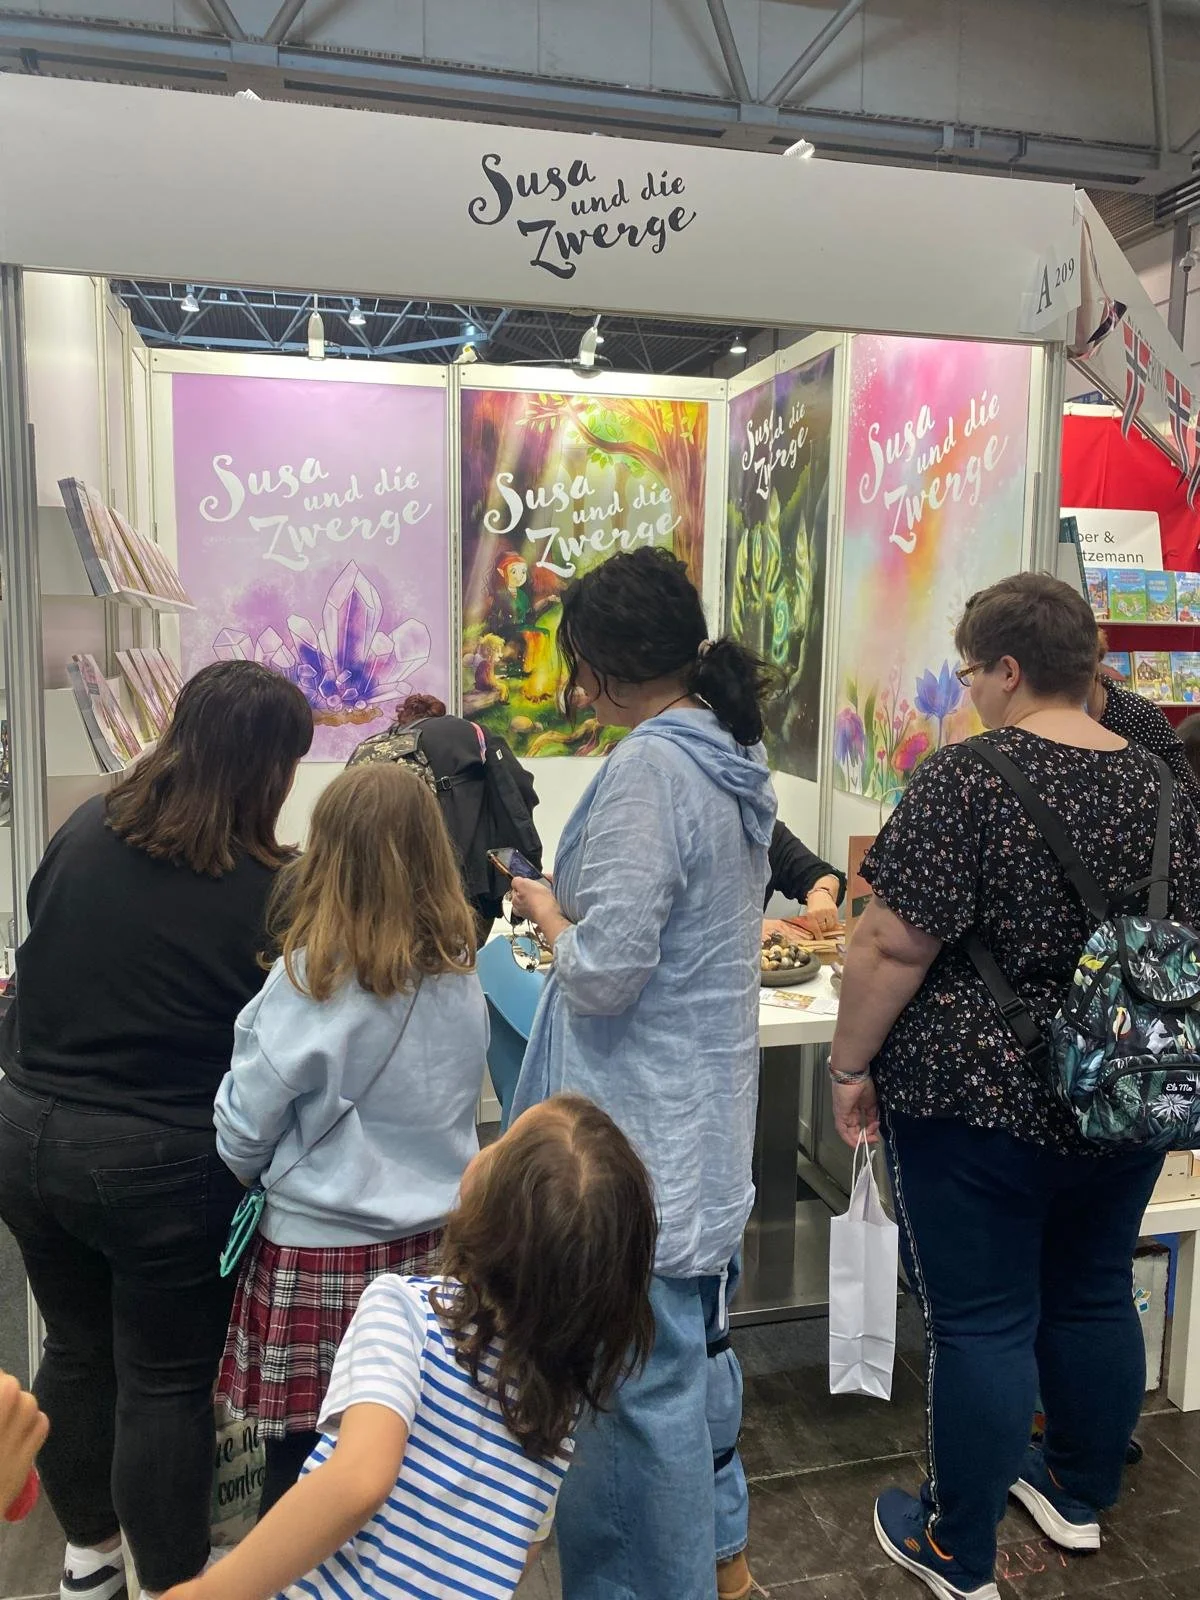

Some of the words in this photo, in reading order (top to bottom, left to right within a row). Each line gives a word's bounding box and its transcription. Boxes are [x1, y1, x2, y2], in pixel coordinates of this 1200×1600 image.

[468, 153, 596, 225] Susa
[571, 178, 630, 216] und
[641, 170, 685, 201] die
[516, 206, 697, 280] Zwerge
[1036, 264, 1052, 315] A
[1055, 257, 1075, 288] 209
[789, 401, 805, 429] die
[916, 416, 957, 474] und
[963, 390, 1000, 438] die
[859, 404, 936, 504] Susa
[199, 454, 329, 522] Susa
[303, 474, 364, 511] und
[374, 466, 420, 496] die
[483, 472, 596, 534] Susa
[572, 491, 624, 524] und
[632, 482, 672, 509] die
[883, 434, 1009, 554] Zwerge
[248, 500, 433, 571] Zwerge
[525, 513, 682, 578] Zwerge
[1081, 550, 1144, 563] tzemann
[1103, 530, 1116, 544] &
